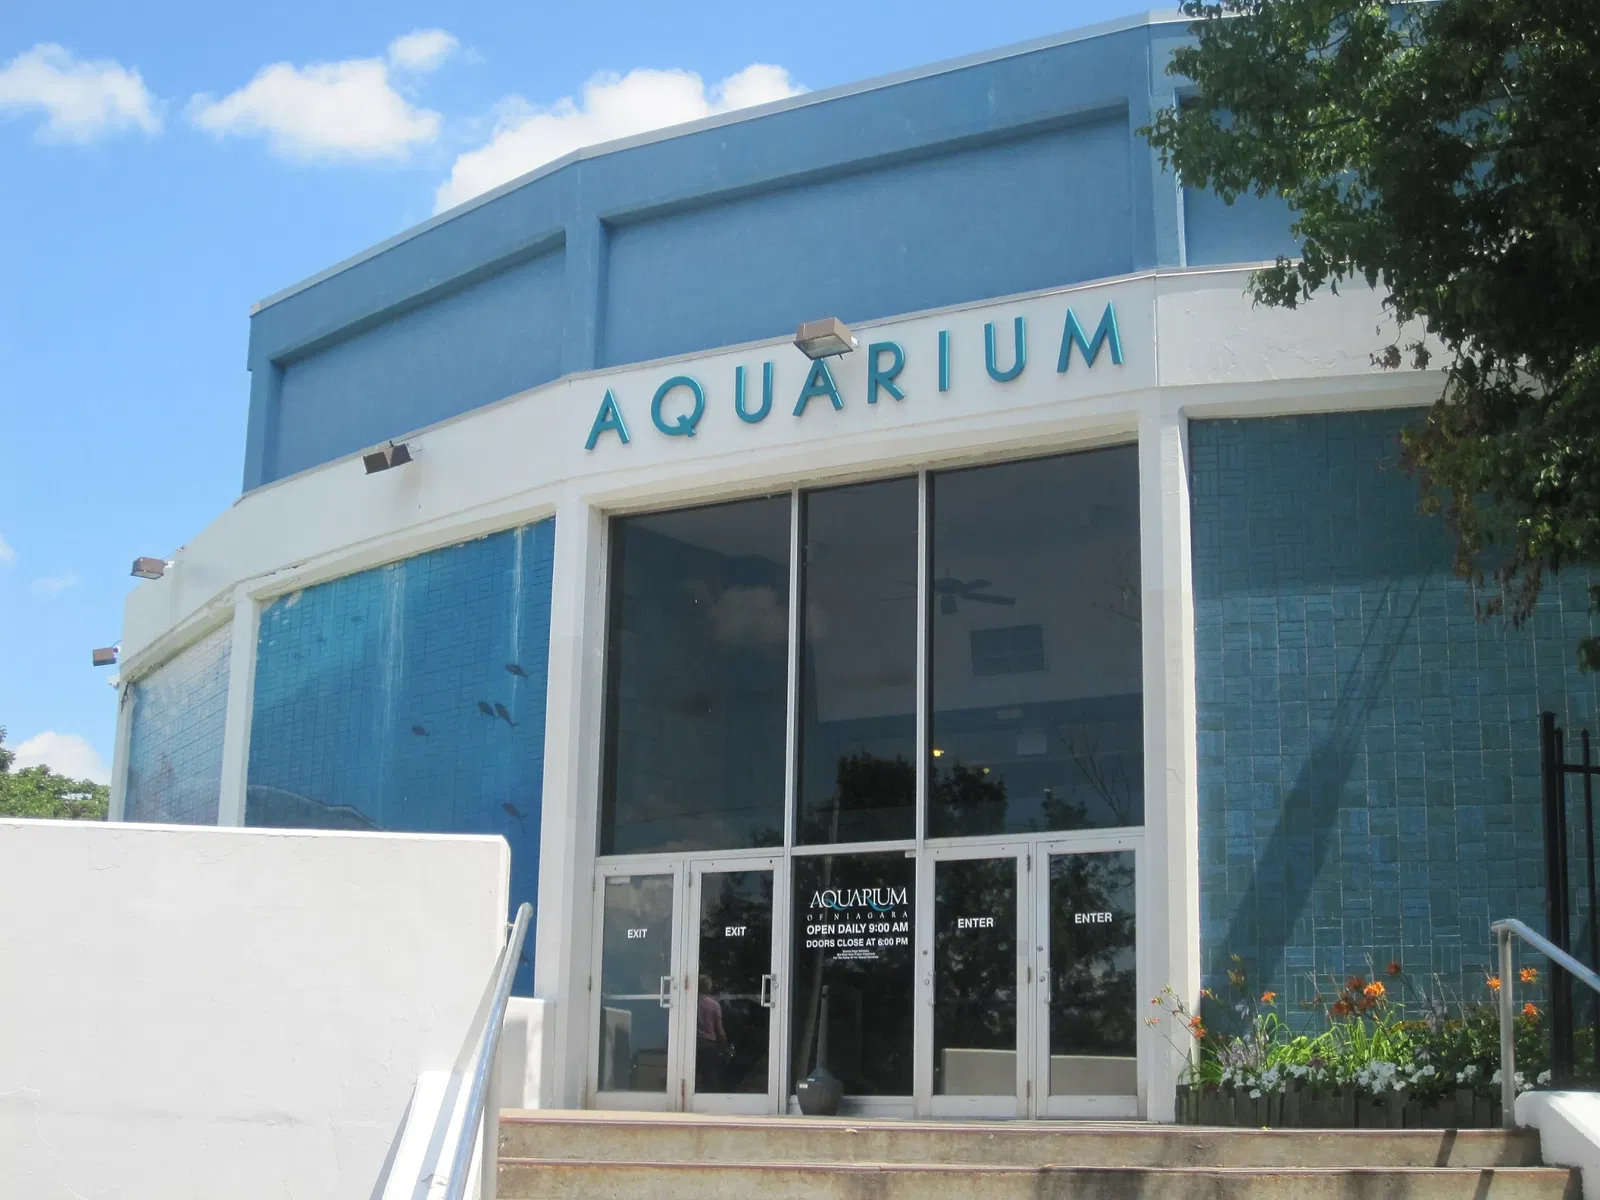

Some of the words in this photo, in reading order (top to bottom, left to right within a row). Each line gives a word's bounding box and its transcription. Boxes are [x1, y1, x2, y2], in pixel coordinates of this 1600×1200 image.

[584, 300, 1123, 450] AQUARIUM
[809, 887, 908, 911] AQUARIUM
[834, 911, 908, 920] NIAGARA
[1074, 912, 1113, 924] ENTER
[806, 924, 835, 935] OPEN
[837, 923, 867, 934] DAILY
[868, 922, 890, 933] 9:00
[891, 921, 909, 932] AM
[957, 917, 994, 928] ENTER
[627, 928, 648, 938] EXIT
[725, 926, 746, 936] EXIT
[806, 939, 835, 949] DOORS
[836, 938, 864, 948] CLOSE
[865, 937, 876, 947] AT
[895, 936, 909, 946] PM
